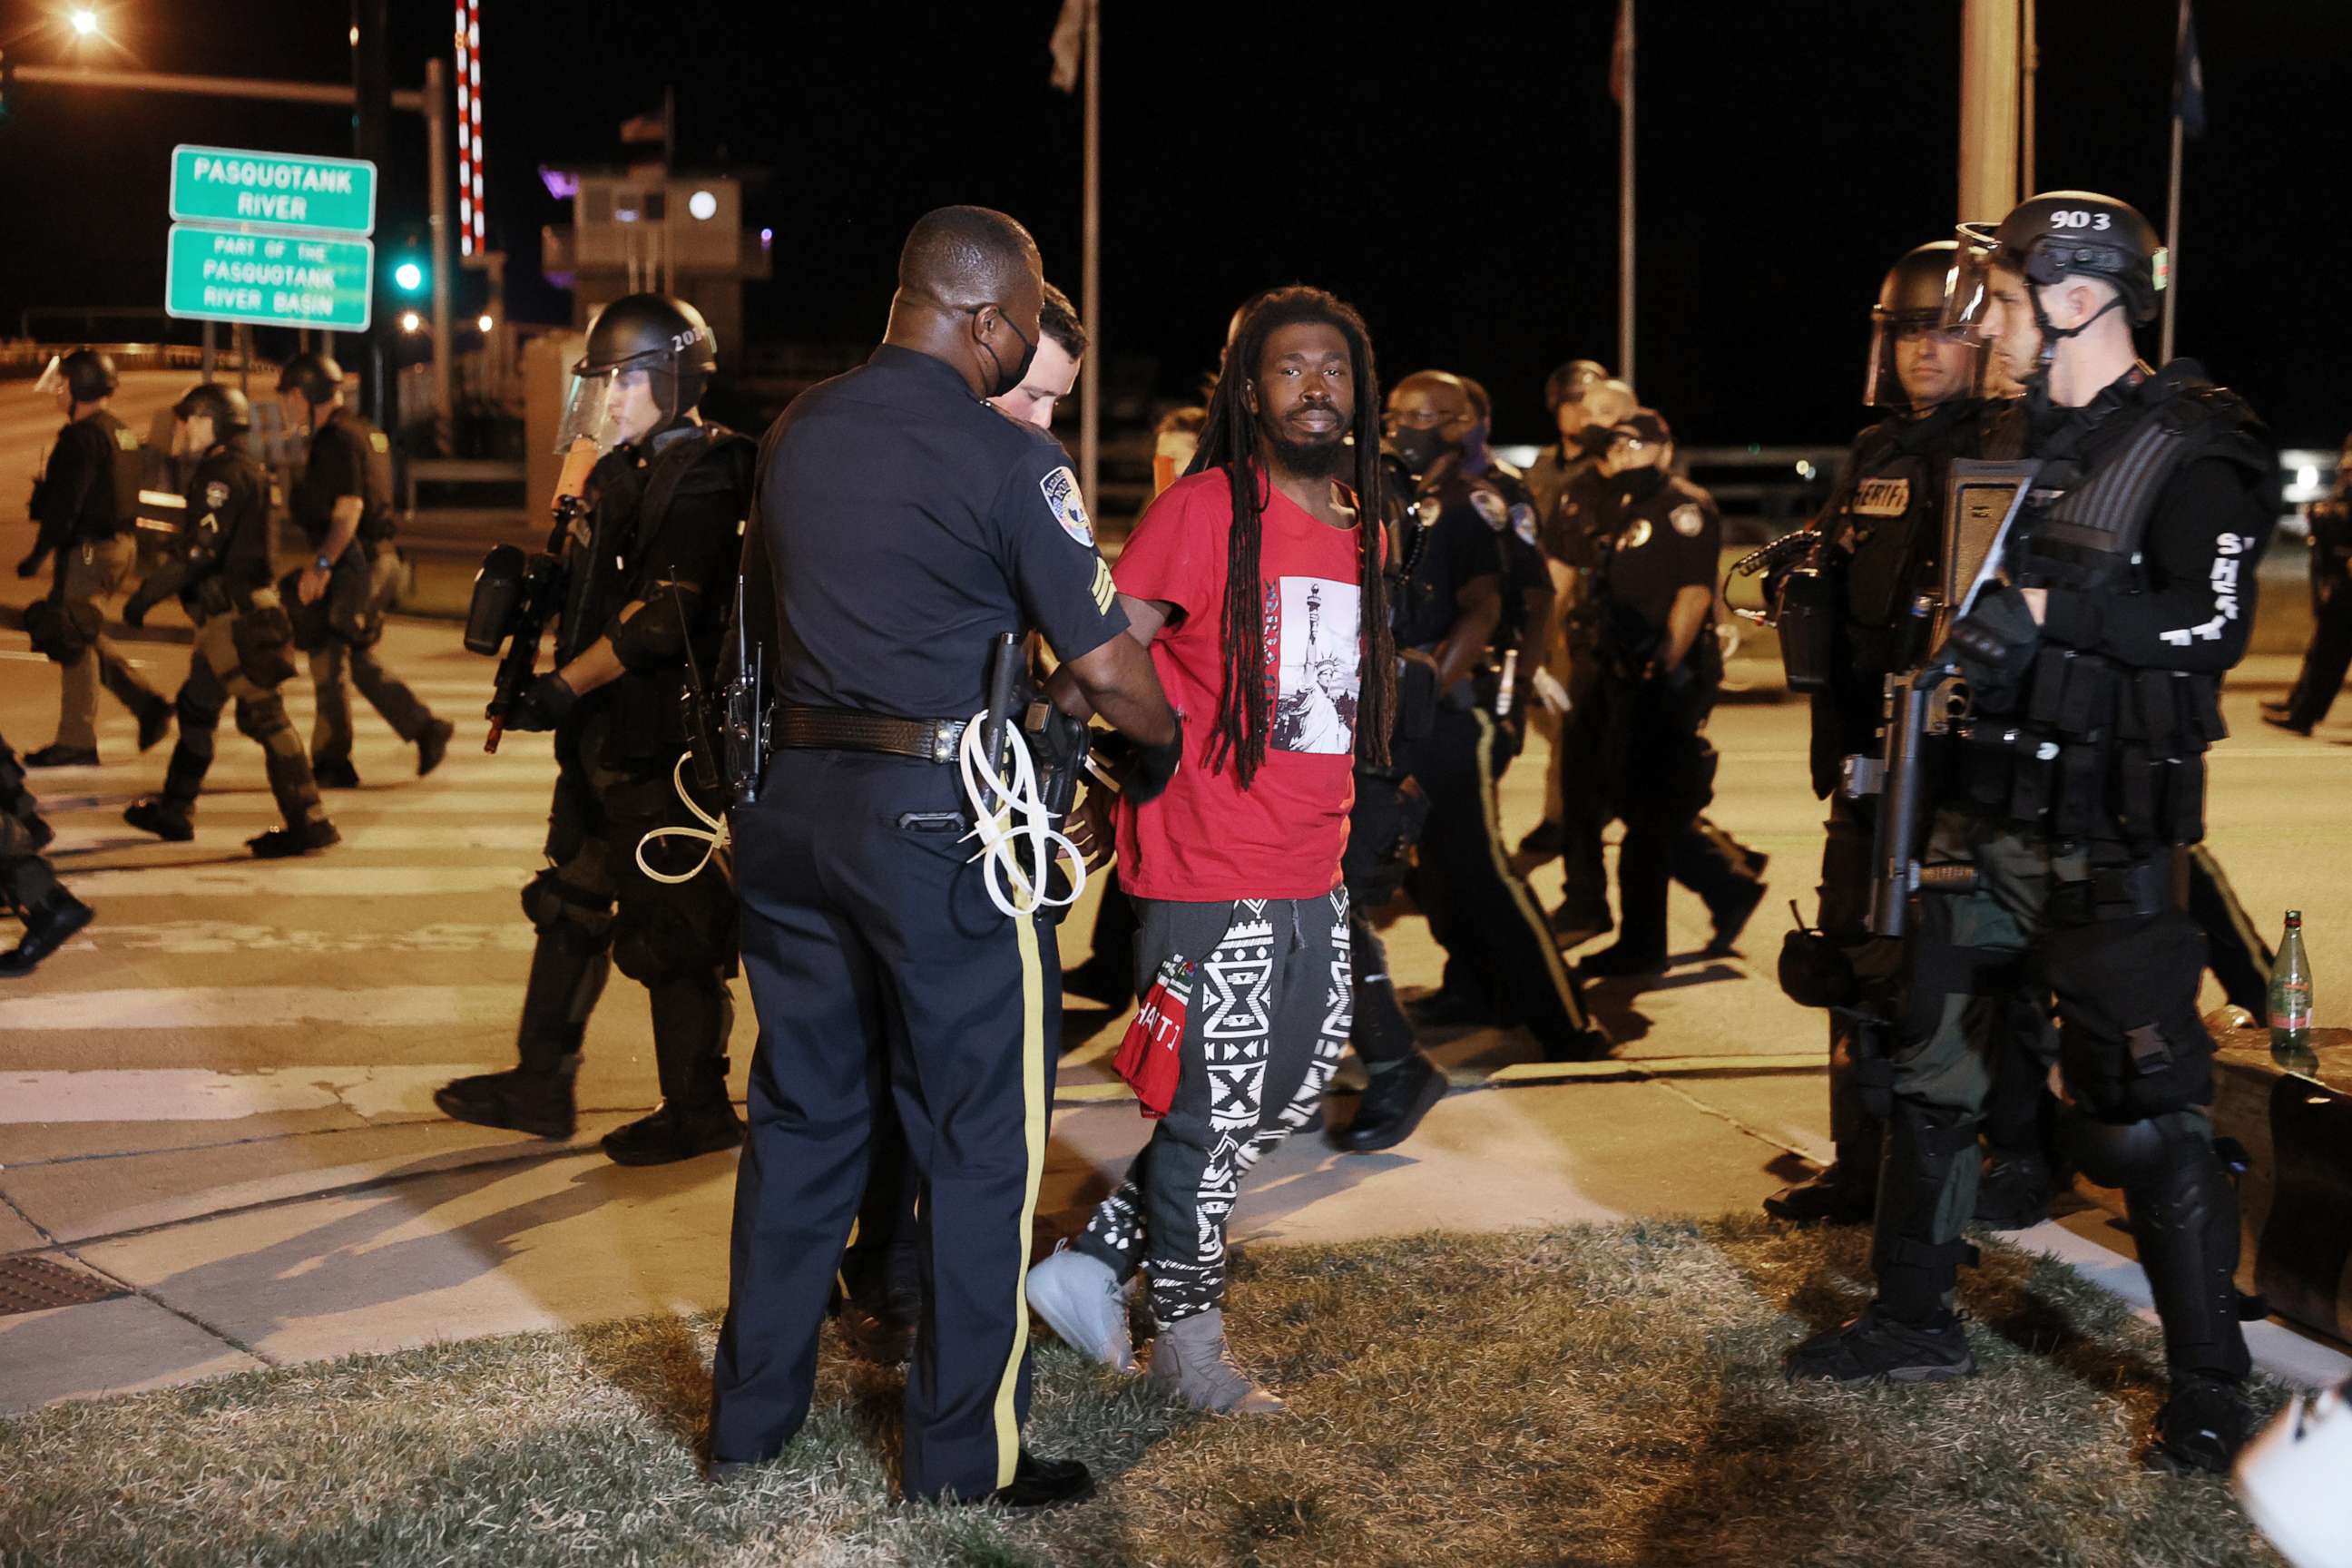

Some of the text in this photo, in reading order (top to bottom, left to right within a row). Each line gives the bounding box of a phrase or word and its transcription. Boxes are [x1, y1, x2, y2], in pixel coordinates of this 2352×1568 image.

[193, 157, 353, 195] PASQUOTANK
[238, 191, 308, 220] RIVER
[2049, 210, 2112, 230] 903
[214, 236, 327, 262] PART OF THE
[202, 259, 336, 290] PASQUOTANK
[204, 286, 334, 316] RIVER BASIN
